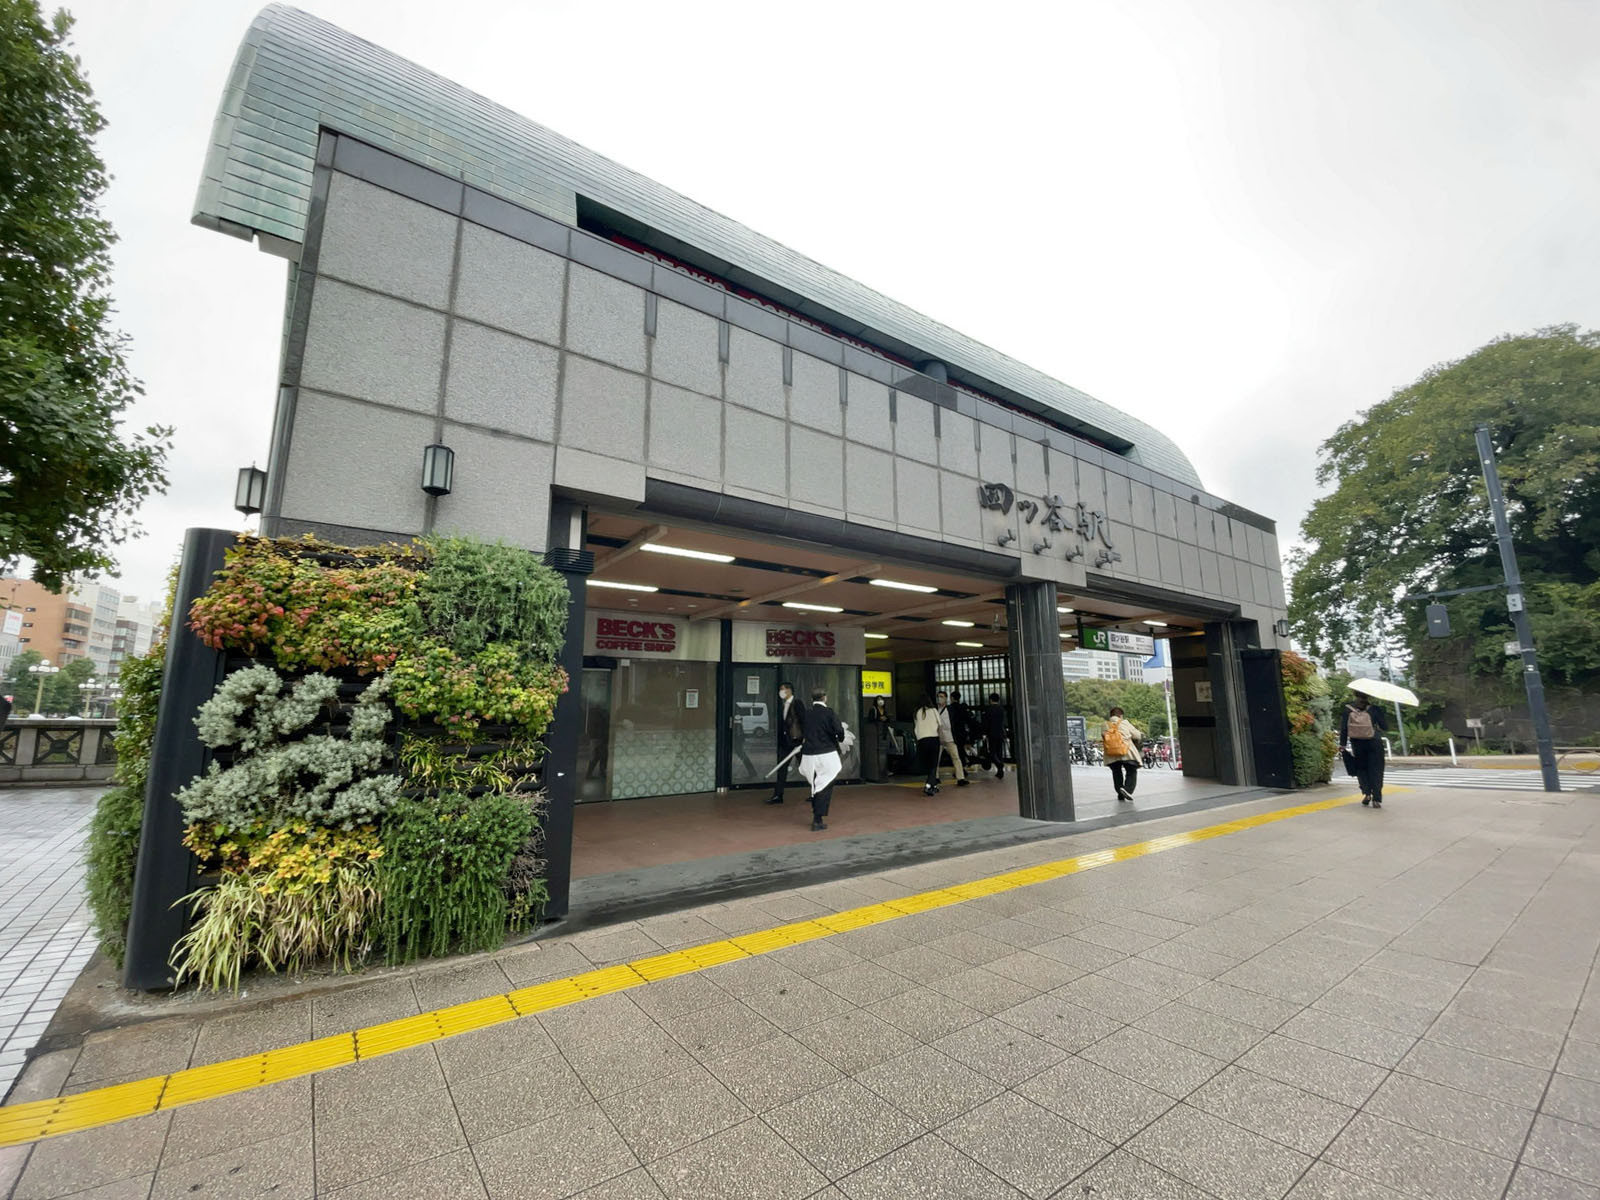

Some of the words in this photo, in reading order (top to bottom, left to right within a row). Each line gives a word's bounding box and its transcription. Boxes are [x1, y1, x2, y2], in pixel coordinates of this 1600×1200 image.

[597, 618, 676, 640] BECK'S
[766, 629, 835, 646] BECK'S
[1093, 631, 1106, 644] JR
[596, 640, 643, 651] COFFEE
[644, 642, 676, 652] SHOP
